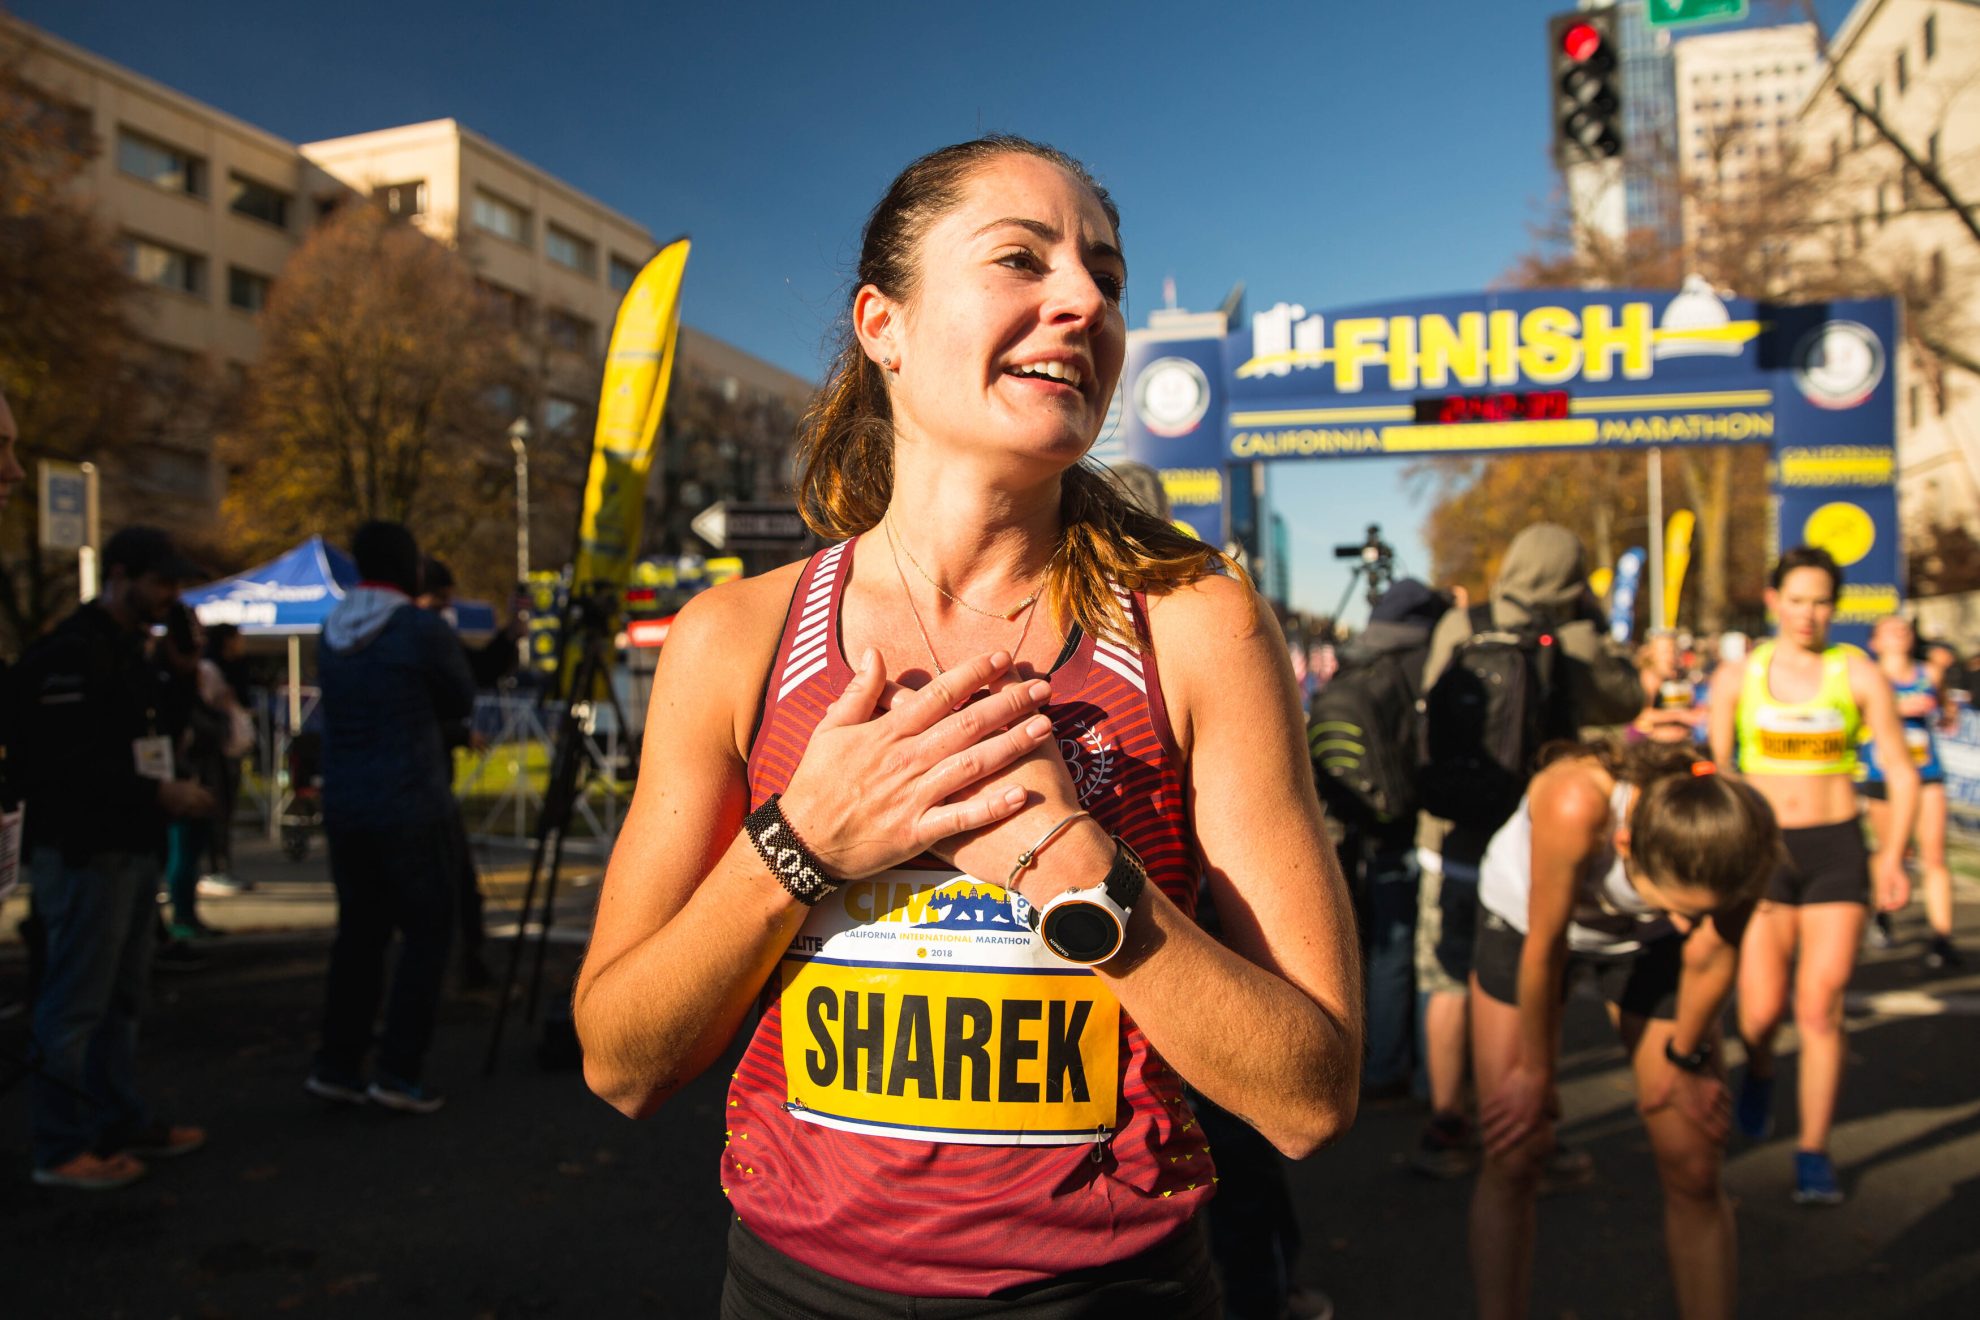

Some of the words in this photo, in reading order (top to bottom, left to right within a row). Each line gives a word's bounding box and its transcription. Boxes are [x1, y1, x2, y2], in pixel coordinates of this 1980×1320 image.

[1334, 303, 1653, 393] FINISH
[1230, 428, 1381, 457] CALIFORNIA
[1601, 412, 1774, 444] MARATHON
[844, 882, 939, 924] CIM
[844, 930, 897, 940] CALIFORNIA
[899, 932, 973, 944] INTERNATIONAL
[975, 935, 1031, 945] MARATHON
[931, 949, 953, 958] 2018
[1048, 938, 1069, 957] GARMIN
[805, 985, 1093, 1103] SHAREK
